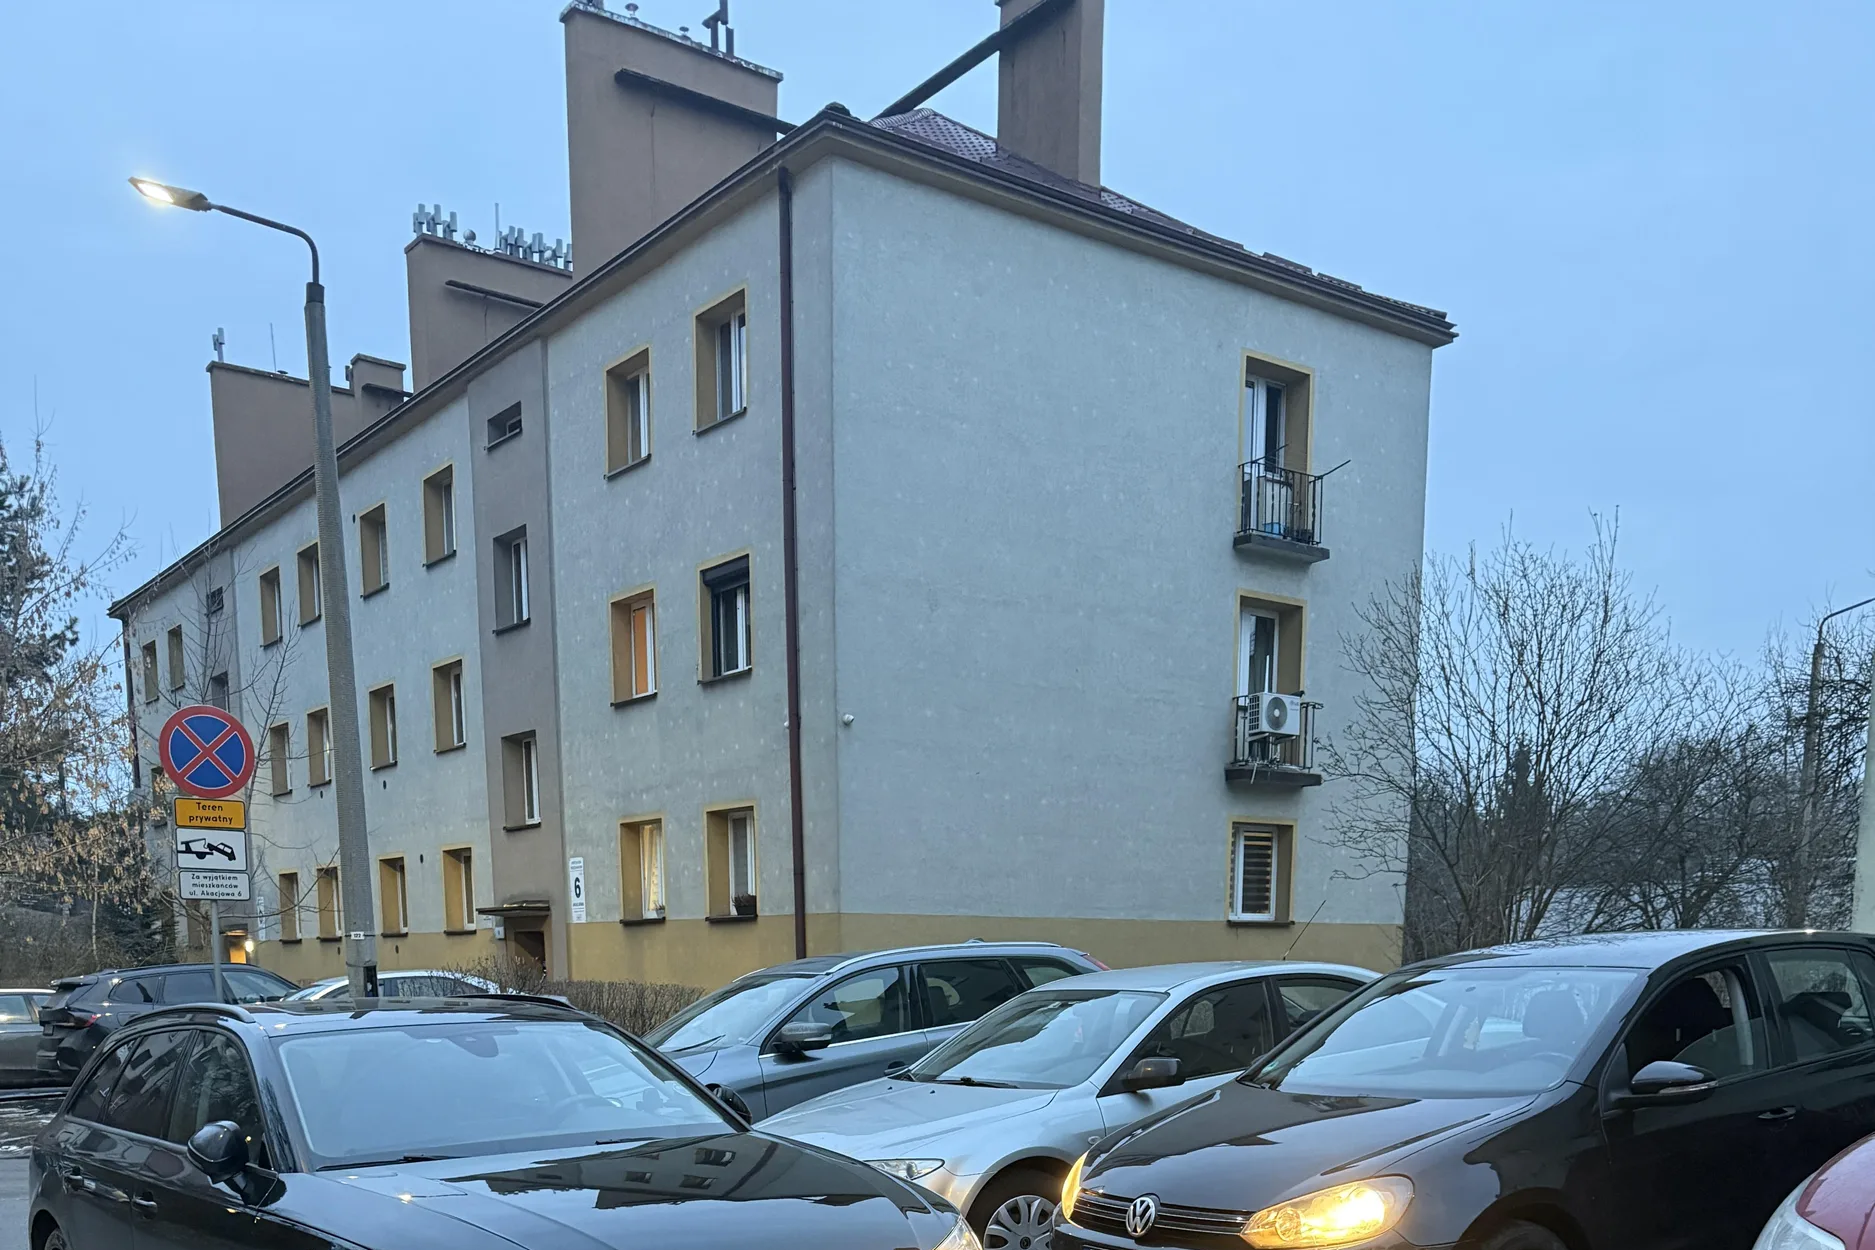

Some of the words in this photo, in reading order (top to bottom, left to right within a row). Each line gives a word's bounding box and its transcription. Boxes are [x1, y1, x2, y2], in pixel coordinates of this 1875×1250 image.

[196, 802, 223, 811] Teren
[189, 815, 233, 825] prywatny
[575, 877, 581, 898] 6
